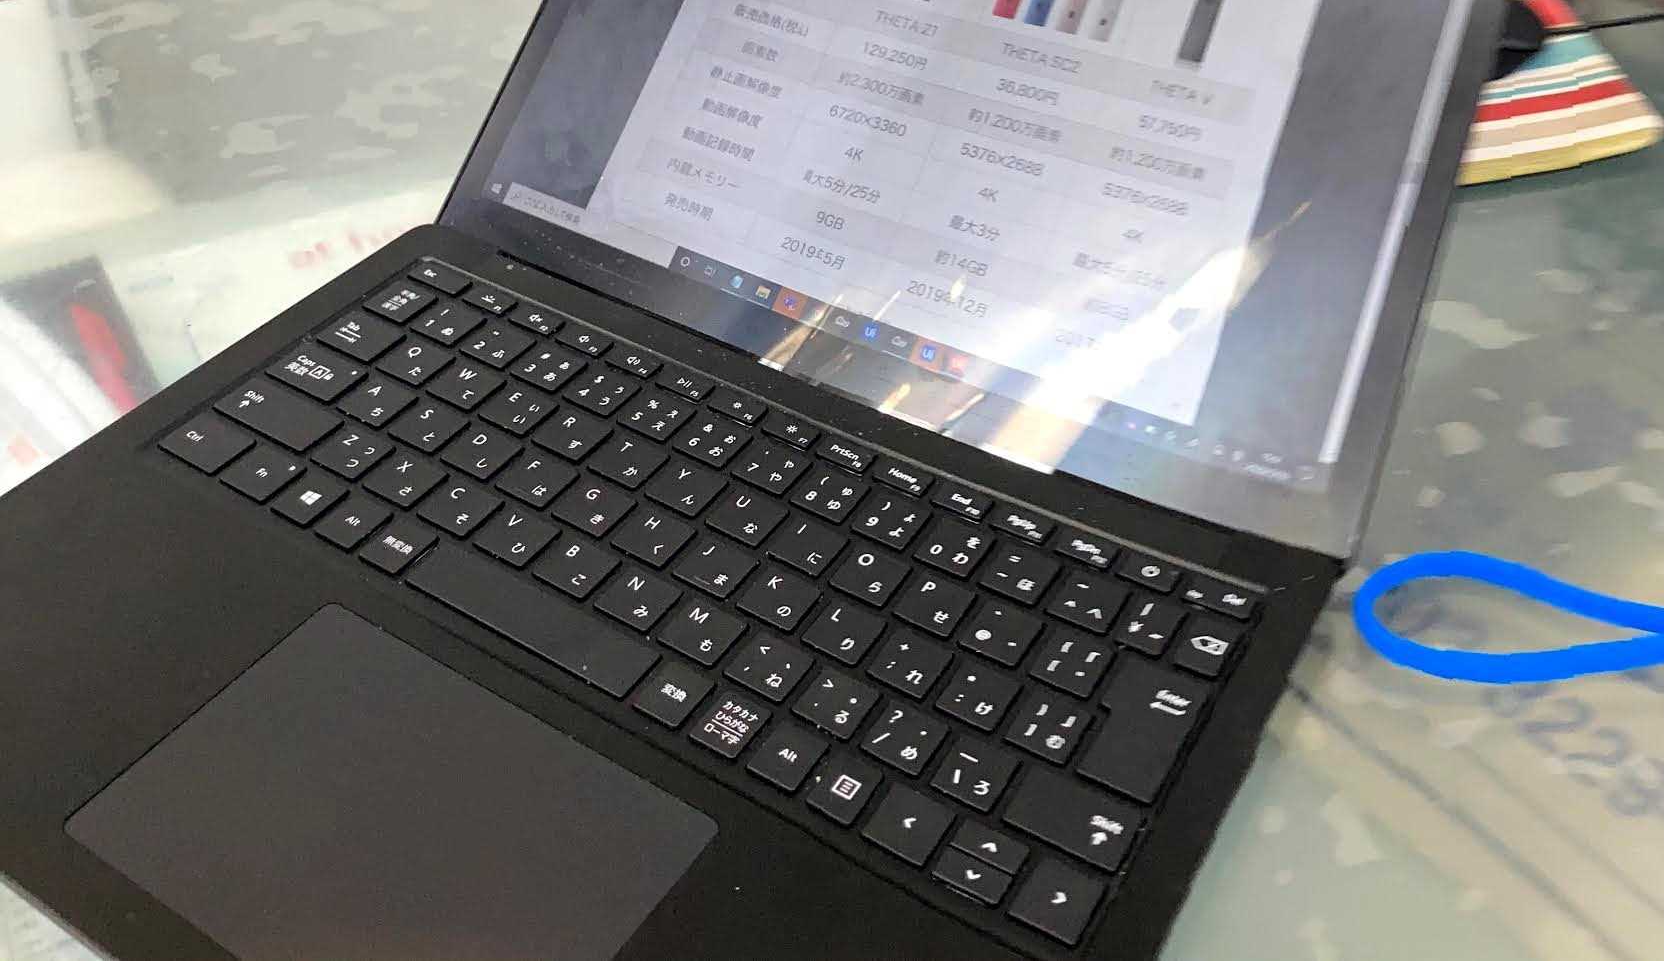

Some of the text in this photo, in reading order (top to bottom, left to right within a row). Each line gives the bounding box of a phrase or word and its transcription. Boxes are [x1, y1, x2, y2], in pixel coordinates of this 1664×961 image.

[875, 10, 920, 35] THETA
[862, 41, 928, 71] 129,250円
[1001, 40, 1048, 66] THETA
[845, 146, 864, 163] 4K
[977, 187, 999, 204] 4K
[815, 210, 845, 231] 9GB
[948, 214, 1001, 243] 最大3分
[425, 319, 435, 327] 1
[474, 341, 485, 349] 2
[408, 347, 421, 358] Q
[524, 364, 536, 372] 3
[459, 369, 477, 380] W
[368, 386, 381, 396] A
[463, 390, 474, 399] て
[245, 391, 264, 403] Shift
[509, 393, 522, 402] E
[421, 410, 433, 419] S
[513, 415, 525, 423] い
[632, 412, 643, 420] 5
[563, 417, 576, 427] R
[703, 424, 713, 432] &
[187, 431, 203, 441] Ctrl
[343, 435, 359, 445] Z
[423, 432, 434, 441] と
[472, 434, 487, 444] D
[621, 442, 633, 451] T
[689, 438, 700, 446] 6
[831, 445, 859, 460] PrtScn
[347, 459, 358, 467] つ
[397, 461, 413, 472] X
[477, 458, 487, 468] し
[528, 461, 540, 469] F
[748, 463, 759, 471] 7
[256, 468, 267, 477] Fn
[623, 467, 637, 475] か
[679, 469, 691, 479] Y
[888, 468, 917, 483] Home
[451, 488, 465, 498] C
[532, 485, 546, 496] は
[586, 489, 600, 499] G
[805, 491, 817, 500] 8
[681, 495, 693, 504] ん
[736, 496, 751, 507] U
[457, 514, 469, 524] そ
[509, 515, 522, 526] V
[645, 517, 660, 529] H
[866, 517, 879, 526] 9
[743, 523, 757, 533] な
[889, 527, 904, 537] よ
[512, 543, 525, 553] ひ
[566, 545, 580, 557] B
[654, 545, 664, 554] く
[703, 546, 715, 555] J
[930, 545, 942, 554] 0
[807, 552, 822, 564] に
[858, 554, 874, 566] O
[572, 574, 586, 585] こ
[628, 577, 645, 590] N
[714, 574, 728, 585] ま
[768, 576, 782, 589] K
[869, 582, 882, 592] ら
[921, 582, 936, 591] P
[633, 606, 648, 617] み
[689, 608, 709, 623] M
[777, 606, 791, 616] の
[831, 609, 841, 622] L
[934, 611, 949, 623] せ
[700, 640, 712, 651] も
[840, 638, 854, 650] り
[766, 674, 782, 687] ね
[906, 670, 923, 684] れ
[661, 683, 686, 702] 変換
[723, 701, 758, 721] カタカナ
[975, 702, 993, 715] け
[716, 710, 749, 732] ひらがな
[835, 710, 849, 723] る
[889, 710, 903, 723] ?
[704, 723, 740, 744] ローマ字
[779, 749, 797, 762] Alt
[901, 746, 917, 759] め
[974, 781, 990, 795] ろ
